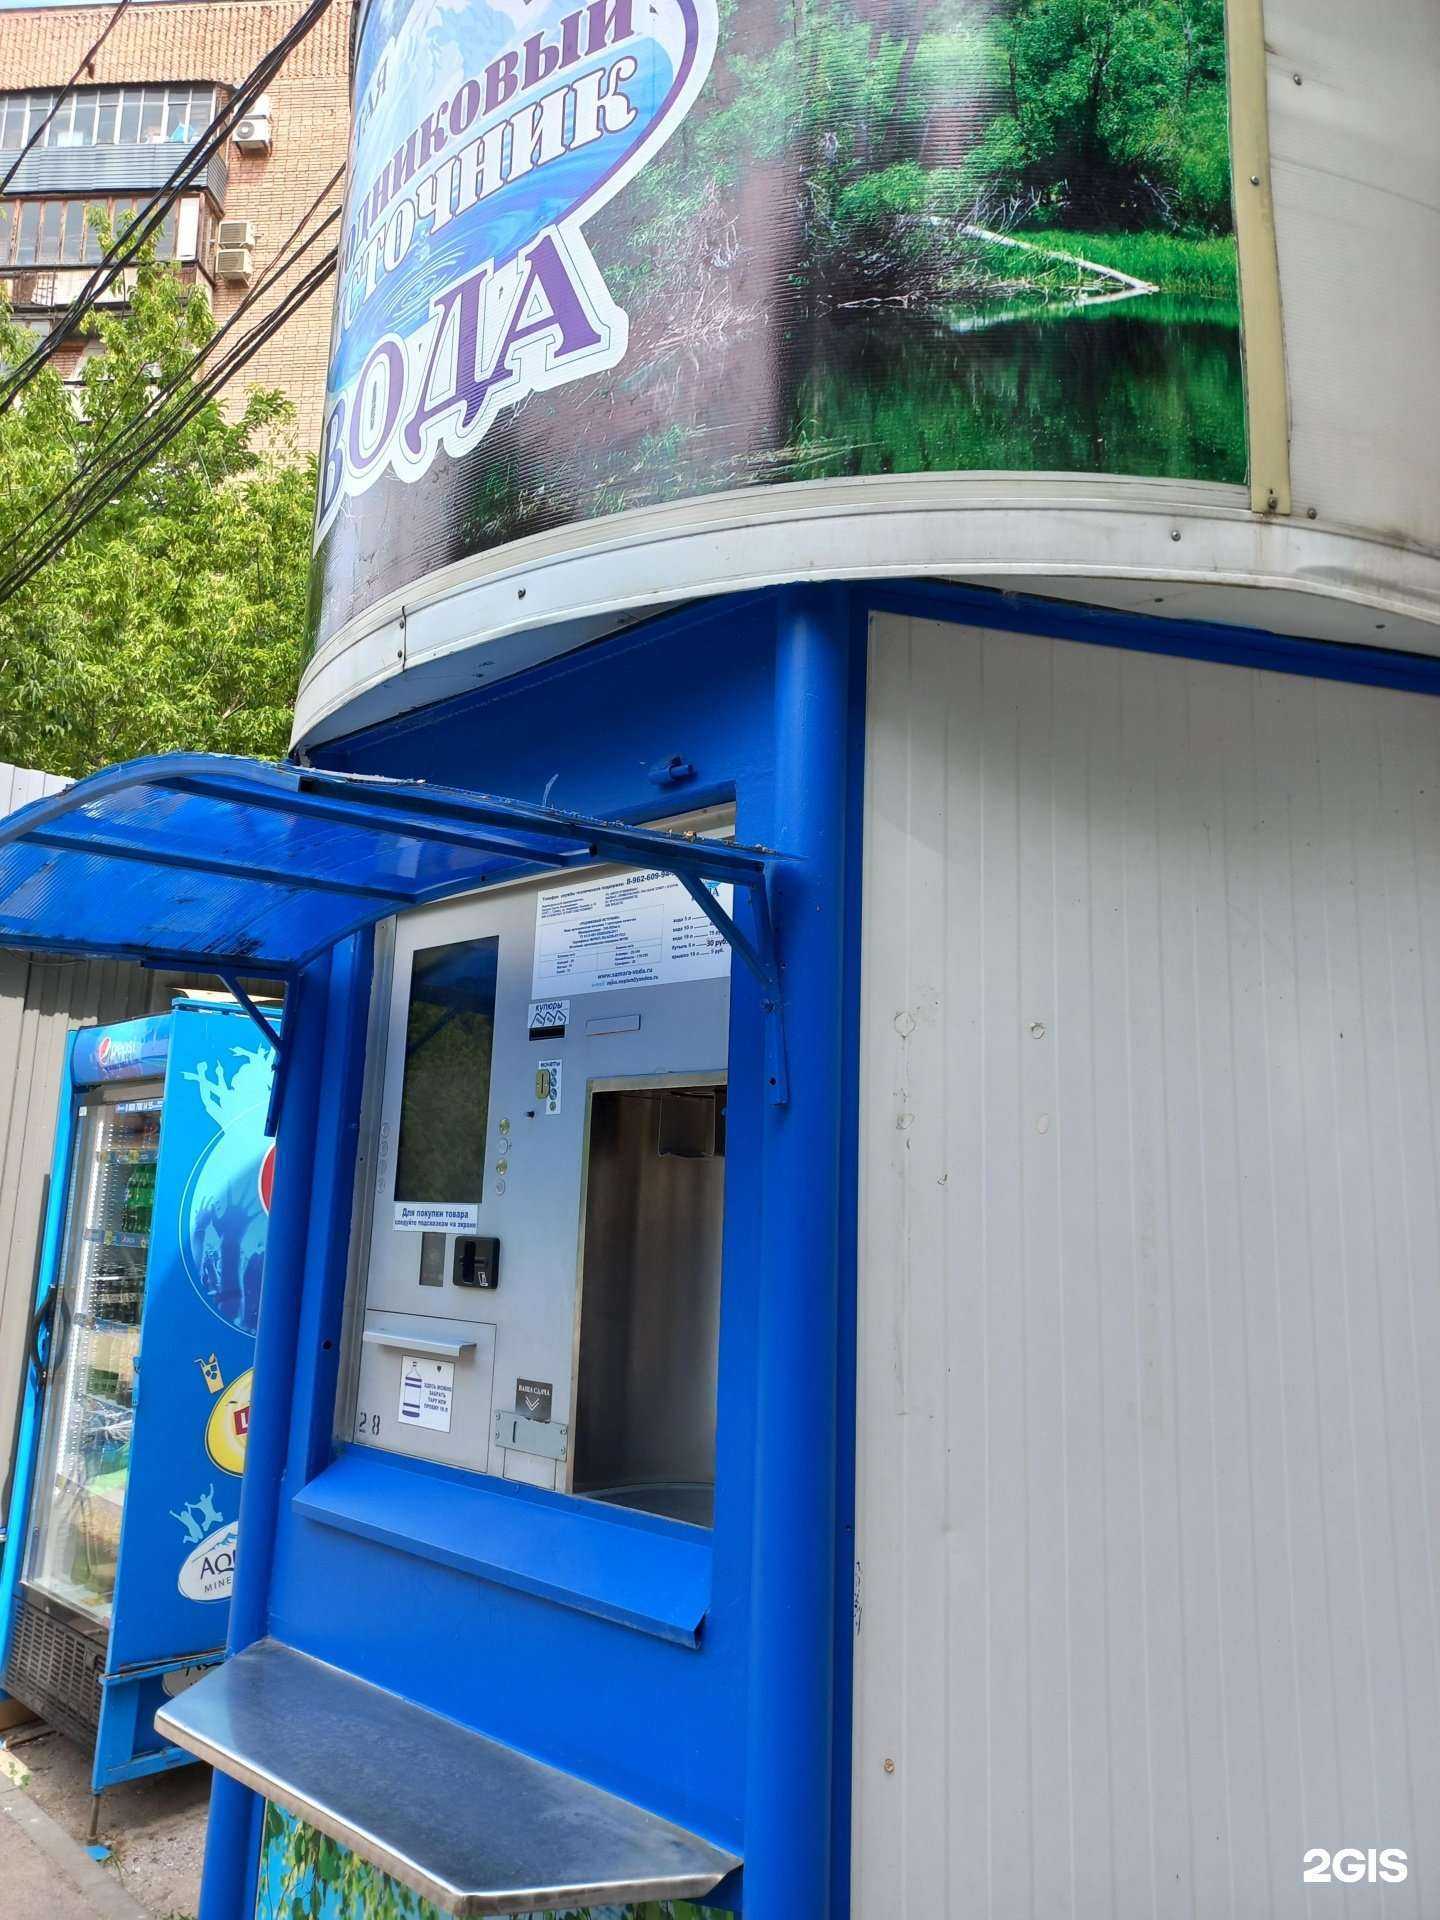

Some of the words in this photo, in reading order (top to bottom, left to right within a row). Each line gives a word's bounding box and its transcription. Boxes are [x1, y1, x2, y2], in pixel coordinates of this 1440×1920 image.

[338, 0, 634, 275] ОДНИКОВЫЙ
[342, 55, 638, 331] СТОЧНИК
[318, 234, 603, 528] ВОДА
[402, 1208, 415, 1218] Для
[416, 1209, 444, 1219] покупки
[445, 1210, 469, 1220] товара
[359, 1411, 380, 1435] 28
[200, 1549, 236, 1580] AQ
[204, 1575, 232, 1593] MINE
